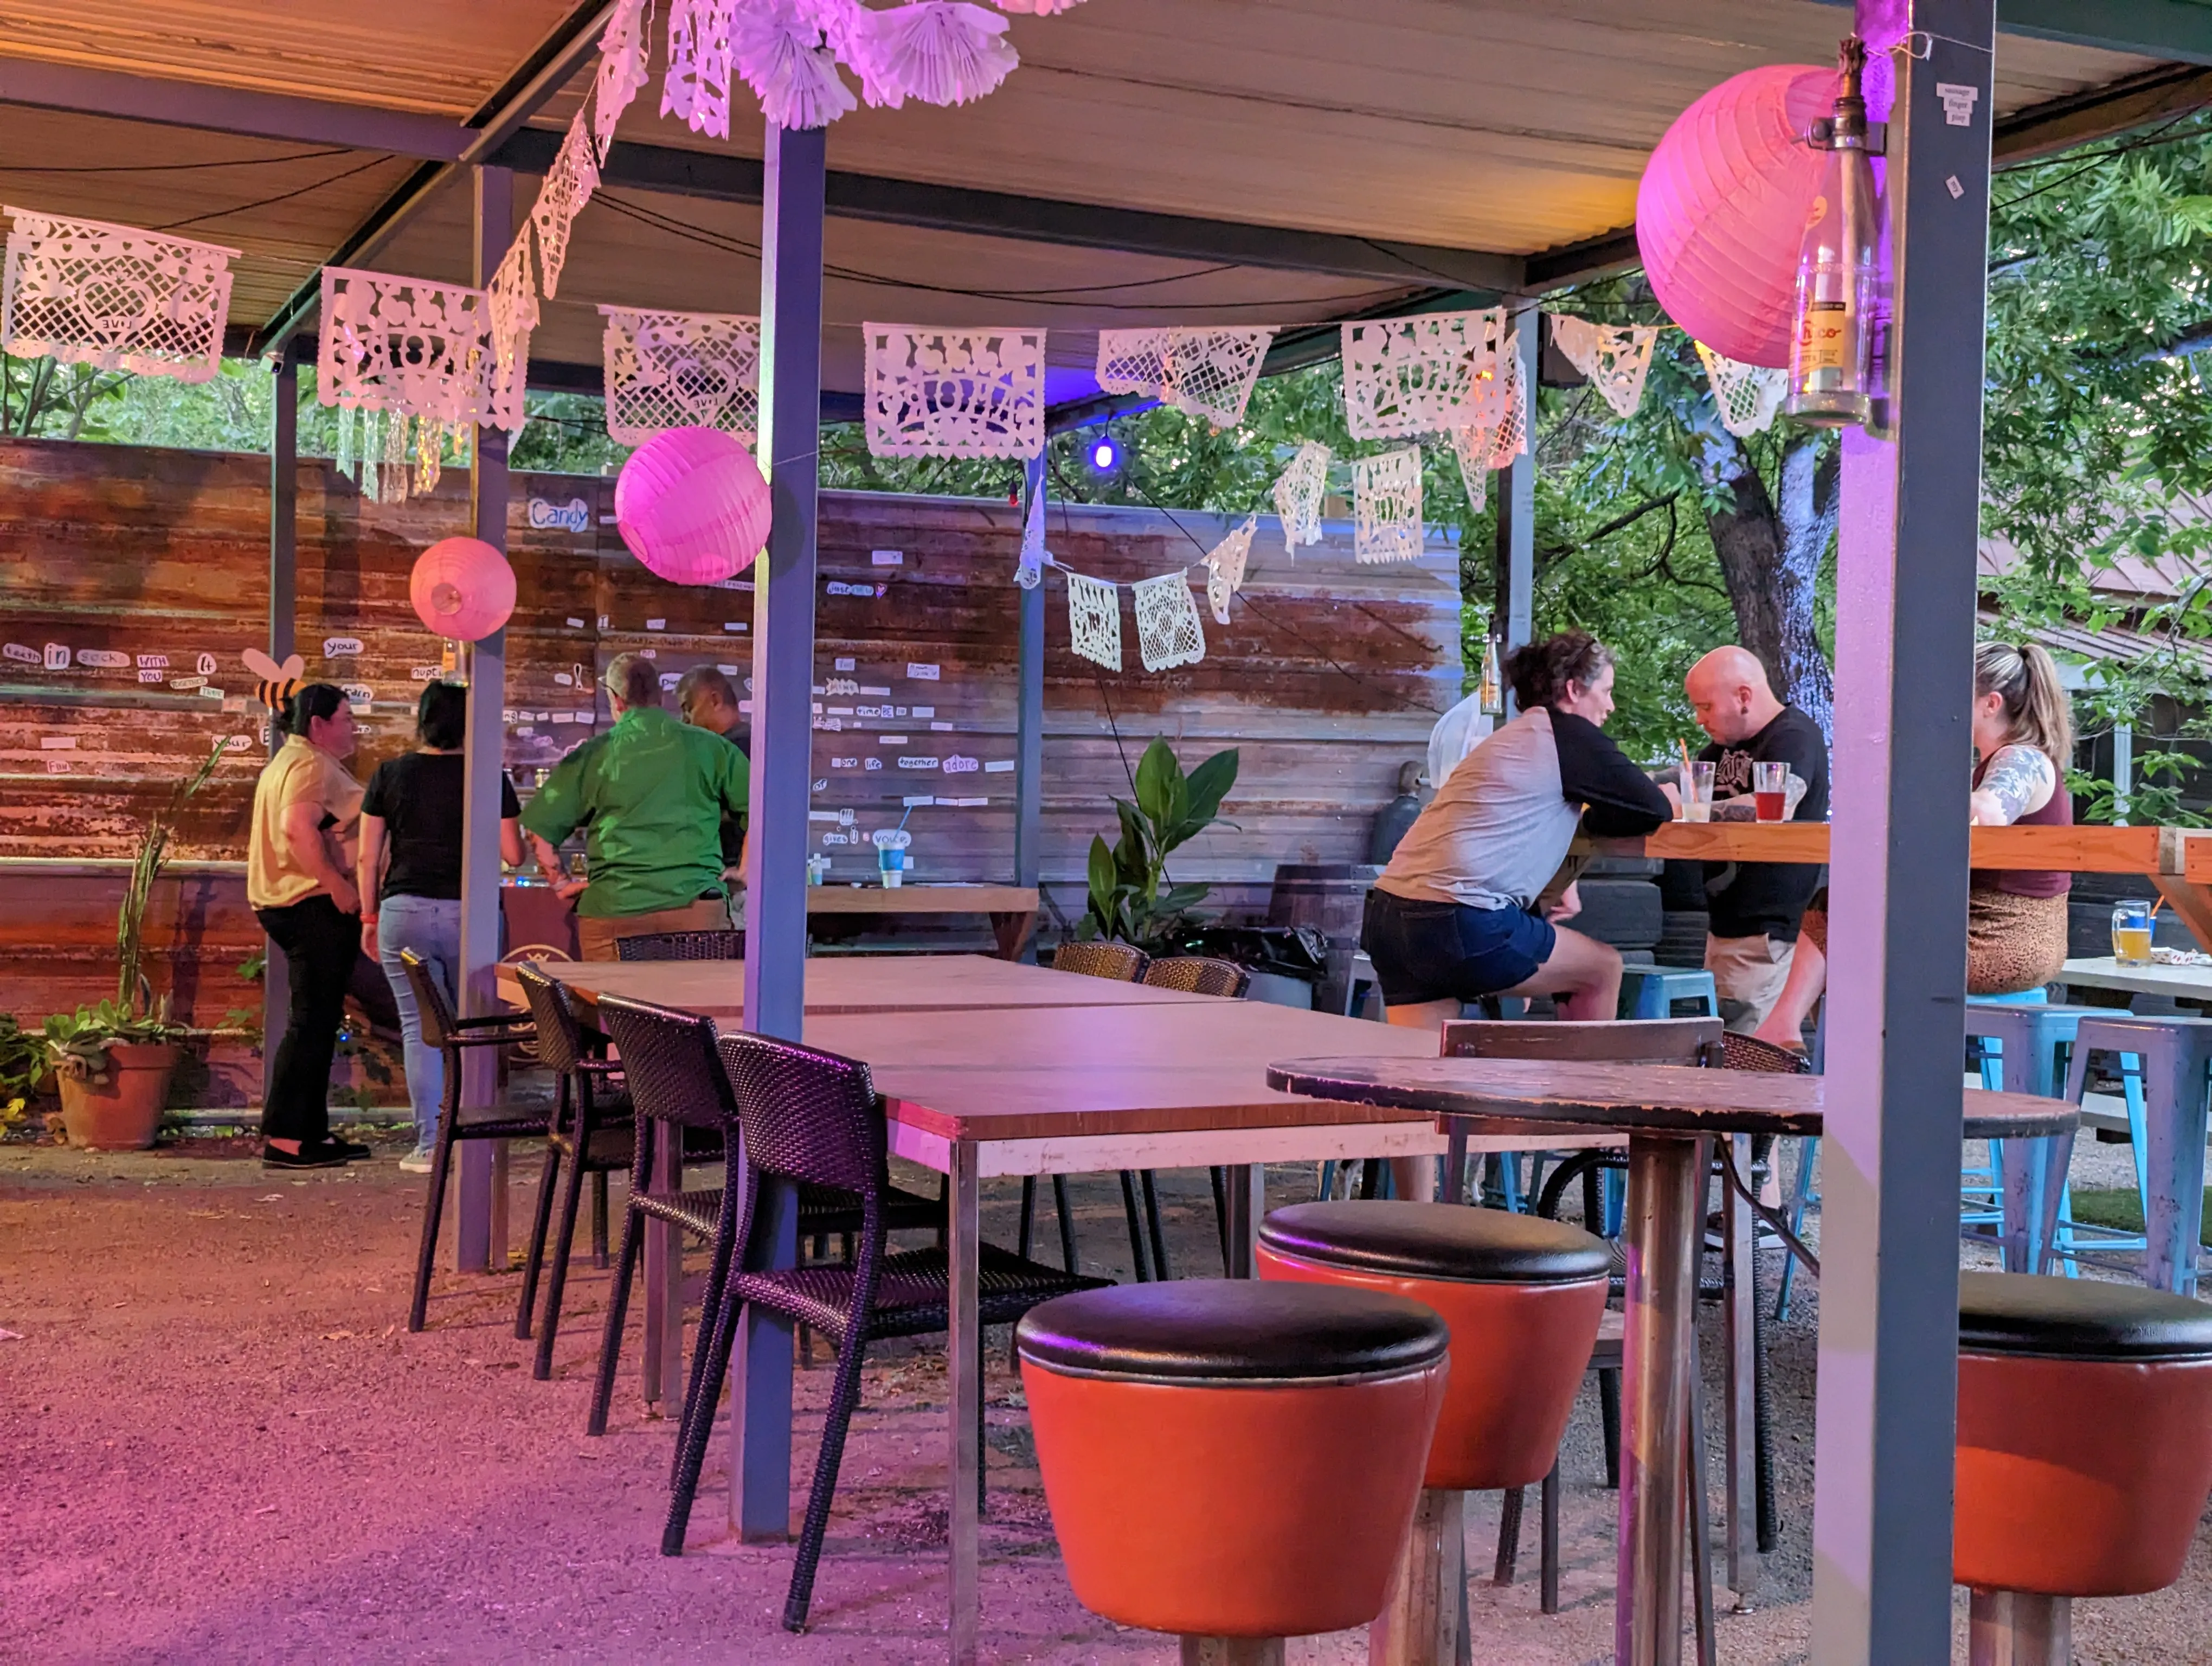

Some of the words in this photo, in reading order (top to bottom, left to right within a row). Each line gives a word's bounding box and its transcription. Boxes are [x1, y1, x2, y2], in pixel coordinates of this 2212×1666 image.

[533, 501, 588, 531] Candy
[327, 643, 359, 654] your
[48, 645, 66, 664] in
[139, 657, 166, 666] WITH
[141, 672, 161, 681] YOU
[858, 707, 879, 715] time
[866, 759, 880, 768] life
[900, 758, 937, 768] together
[945, 755, 977, 771] adore
